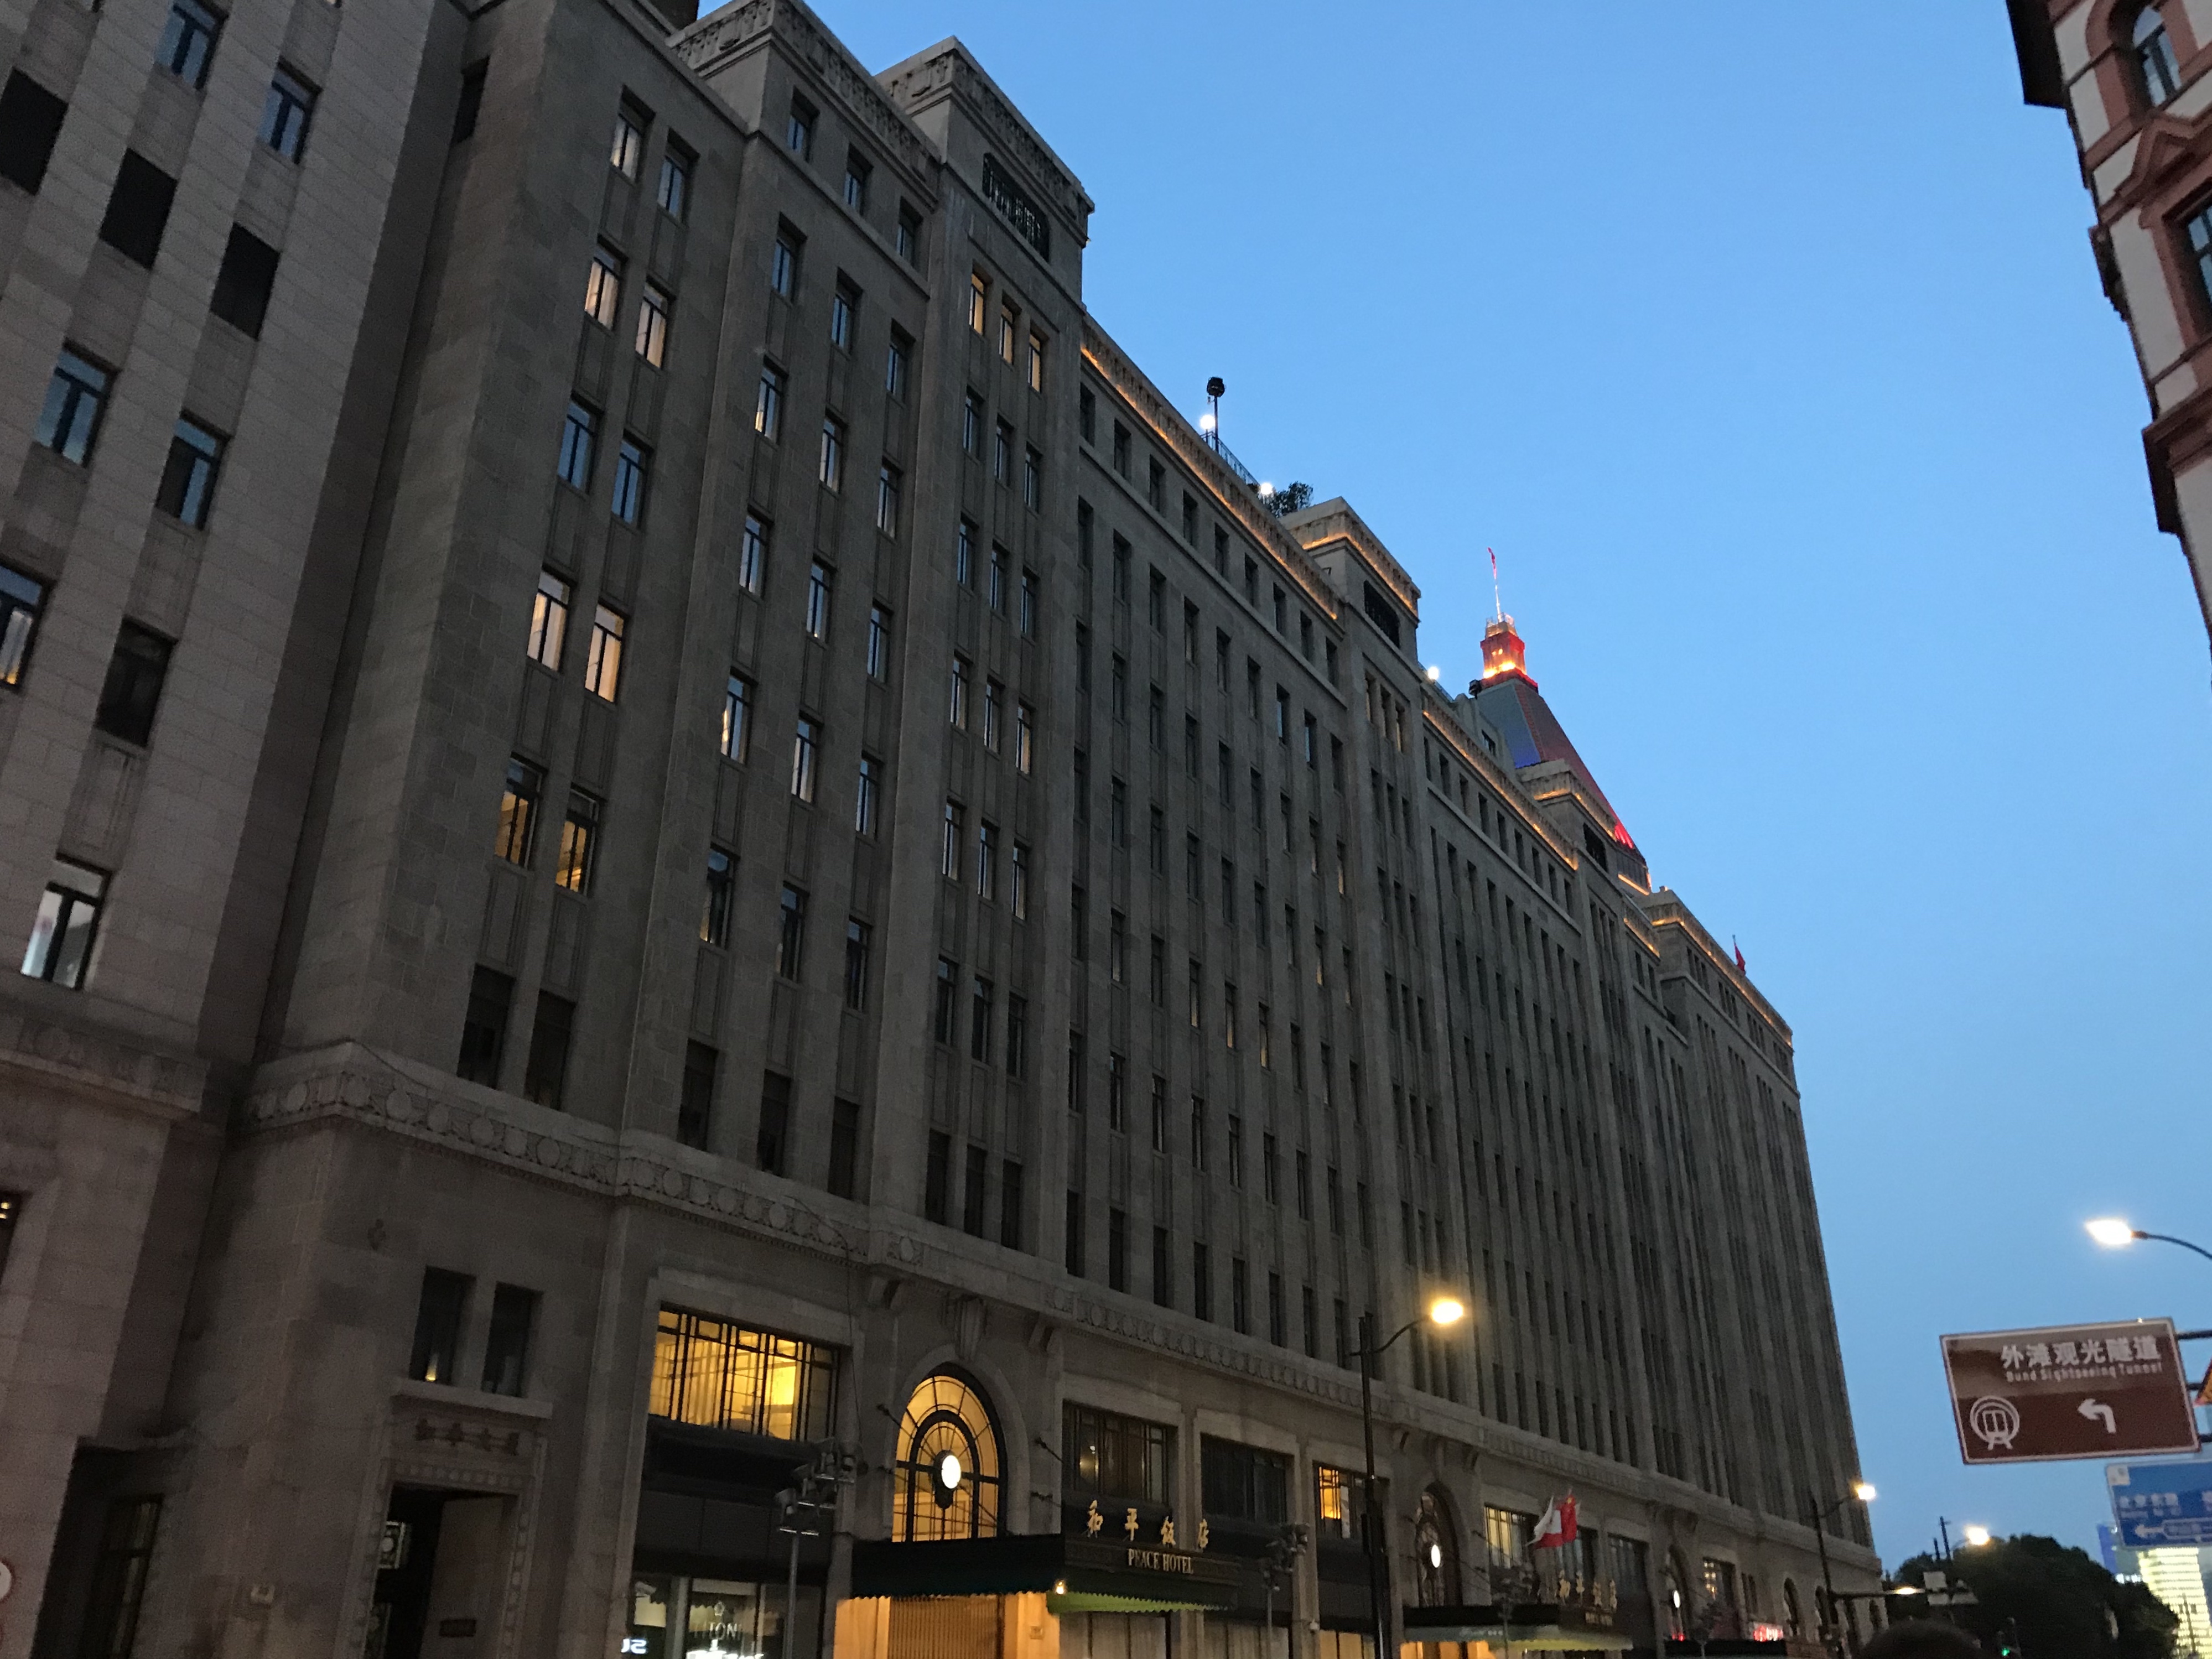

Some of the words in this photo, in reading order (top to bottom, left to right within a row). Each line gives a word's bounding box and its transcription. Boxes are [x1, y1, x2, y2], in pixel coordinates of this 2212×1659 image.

[2001, 1335, 2161, 1369] 外滩观光隧道
[2006, 1370, 2037, 1382] Bund
[1128, 1548, 1160, 1570] PEACE
[1163, 1553, 1194, 1574] HOTEL
